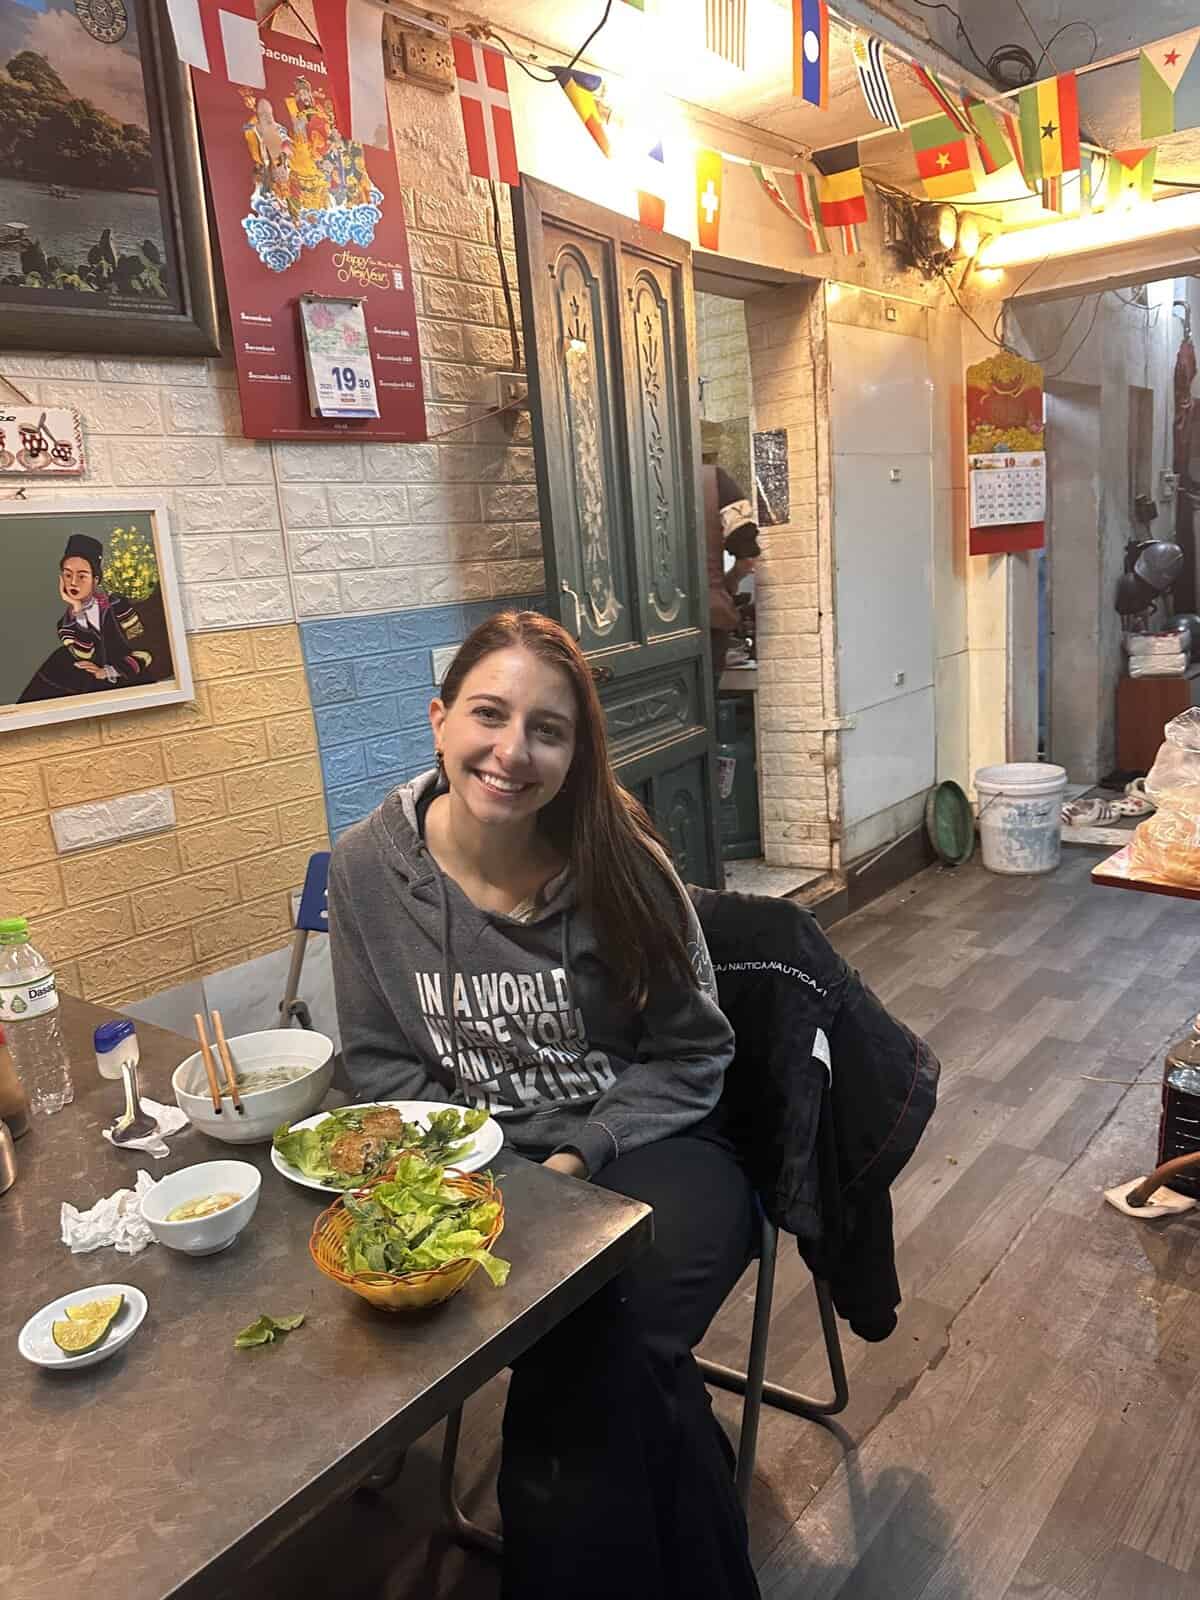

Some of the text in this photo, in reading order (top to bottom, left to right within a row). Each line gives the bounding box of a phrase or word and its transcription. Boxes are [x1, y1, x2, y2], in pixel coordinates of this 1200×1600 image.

[332, 249, 372, 270] Happy
[332, 366, 357, 391] 19
[729, 961, 767, 970] NAUTICA
[769, 961, 817, 989] NAUTICA
[416, 967, 570, 1018] IN A WORLD
